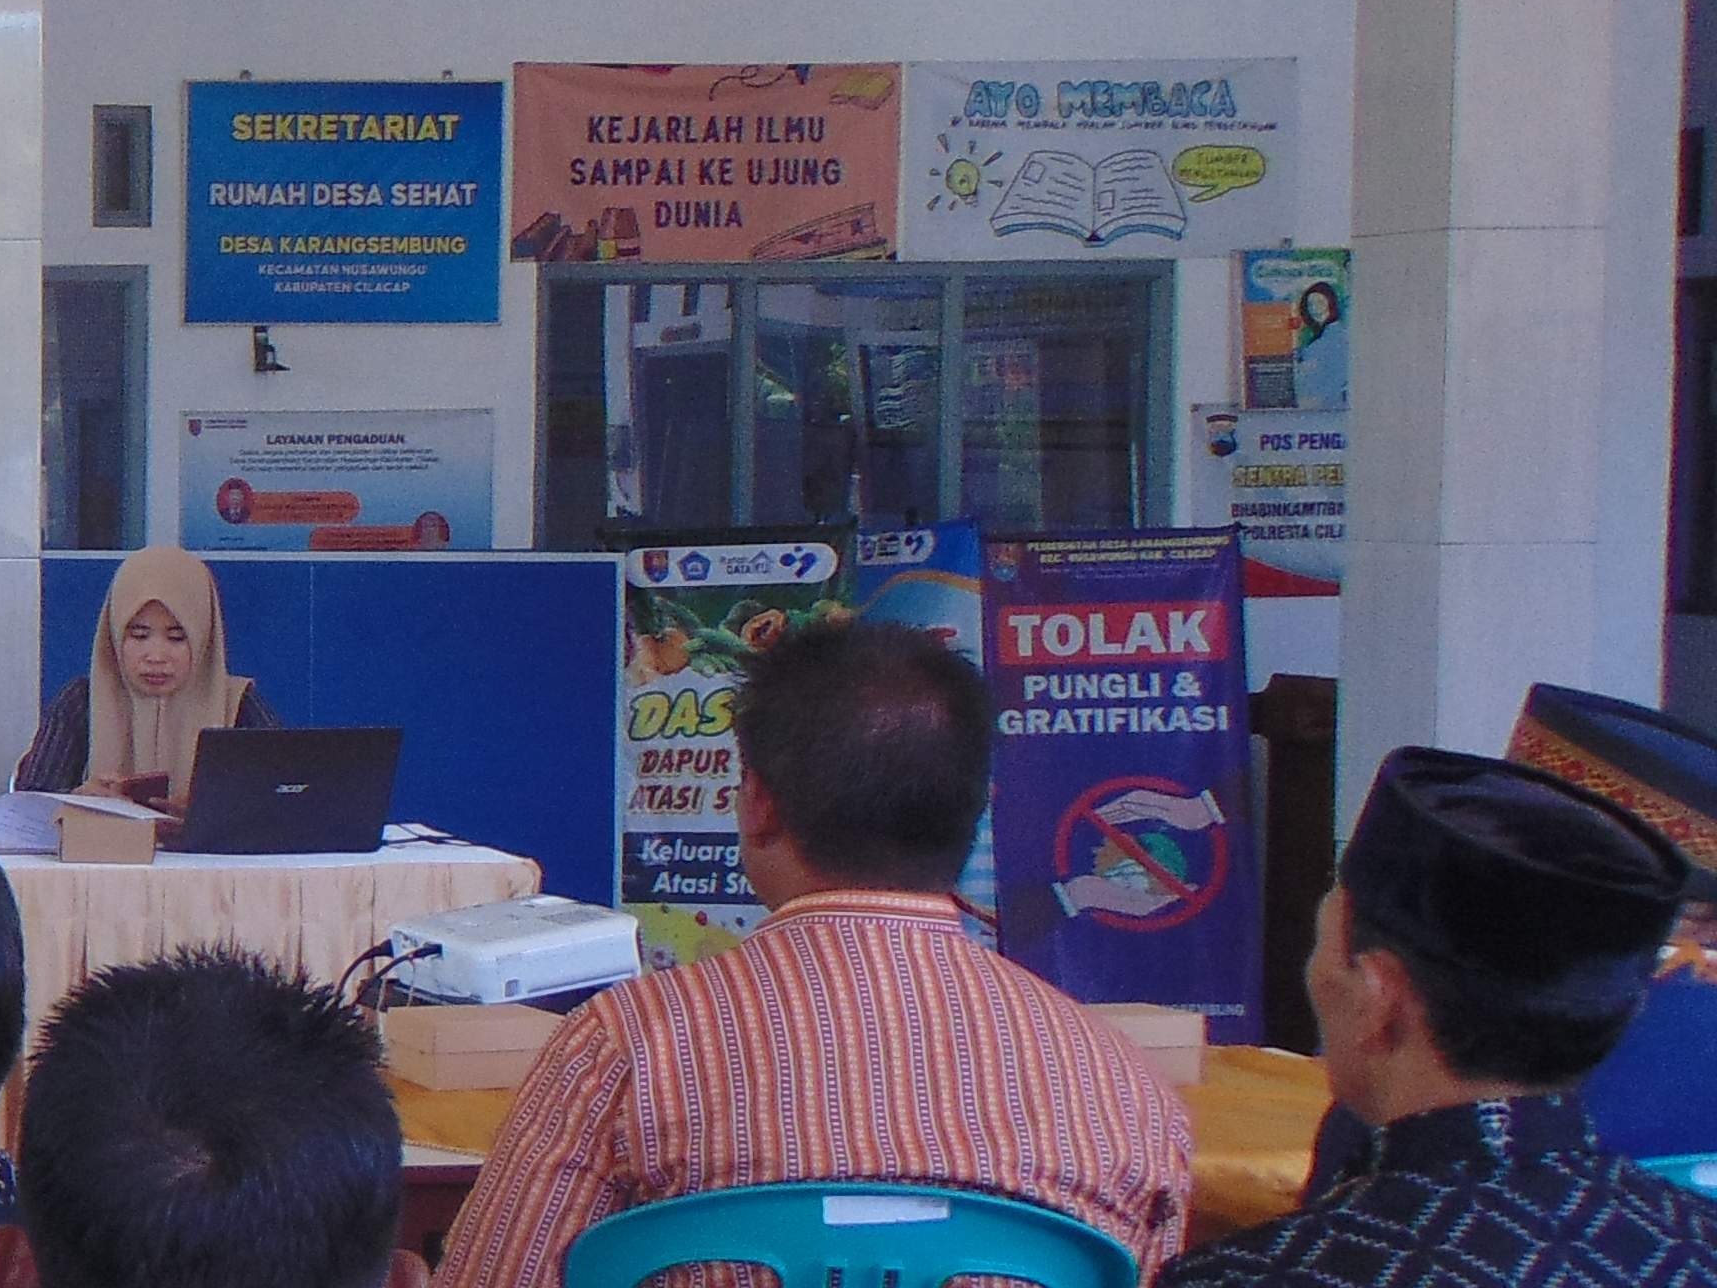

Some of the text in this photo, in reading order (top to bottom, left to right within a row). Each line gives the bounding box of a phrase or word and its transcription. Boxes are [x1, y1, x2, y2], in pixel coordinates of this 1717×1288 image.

[1057, 80, 1238, 118] MEMBACA
[231, 114, 460, 142] SEKRETARIAT
[587, 115, 825, 144] KEJARLAH ILMU
[570, 158, 842, 186] SAMPAI KE UJUNG
[208, 182, 478, 206] RUMAH DESA SEHAT
[655, 201, 744, 229] DUNIA
[219, 235, 467, 255] DESA KARANGSEMBUNG
[258, 263, 339, 276] KECAMATAN
[274, 281, 411, 293] KABUPATEN CILACAP
[266, 433, 406, 445] LAYANAN PENGADUAN
[1259, 432, 1346, 451] POS PENG
[1008, 610, 1212, 657] TOLAK
[1023, 671, 1202, 700] PUNGLI &
[628, 688, 736, 741] DAS
[997, 705, 1229, 734] GRATIFIKASI
[639, 748, 731, 777] DAPUR
[276, 784, 309, 793] acer
[628, 784, 705, 814] ATASI
[642, 839, 741, 866] Keluarg
[651, 871, 717, 894] Atasi
